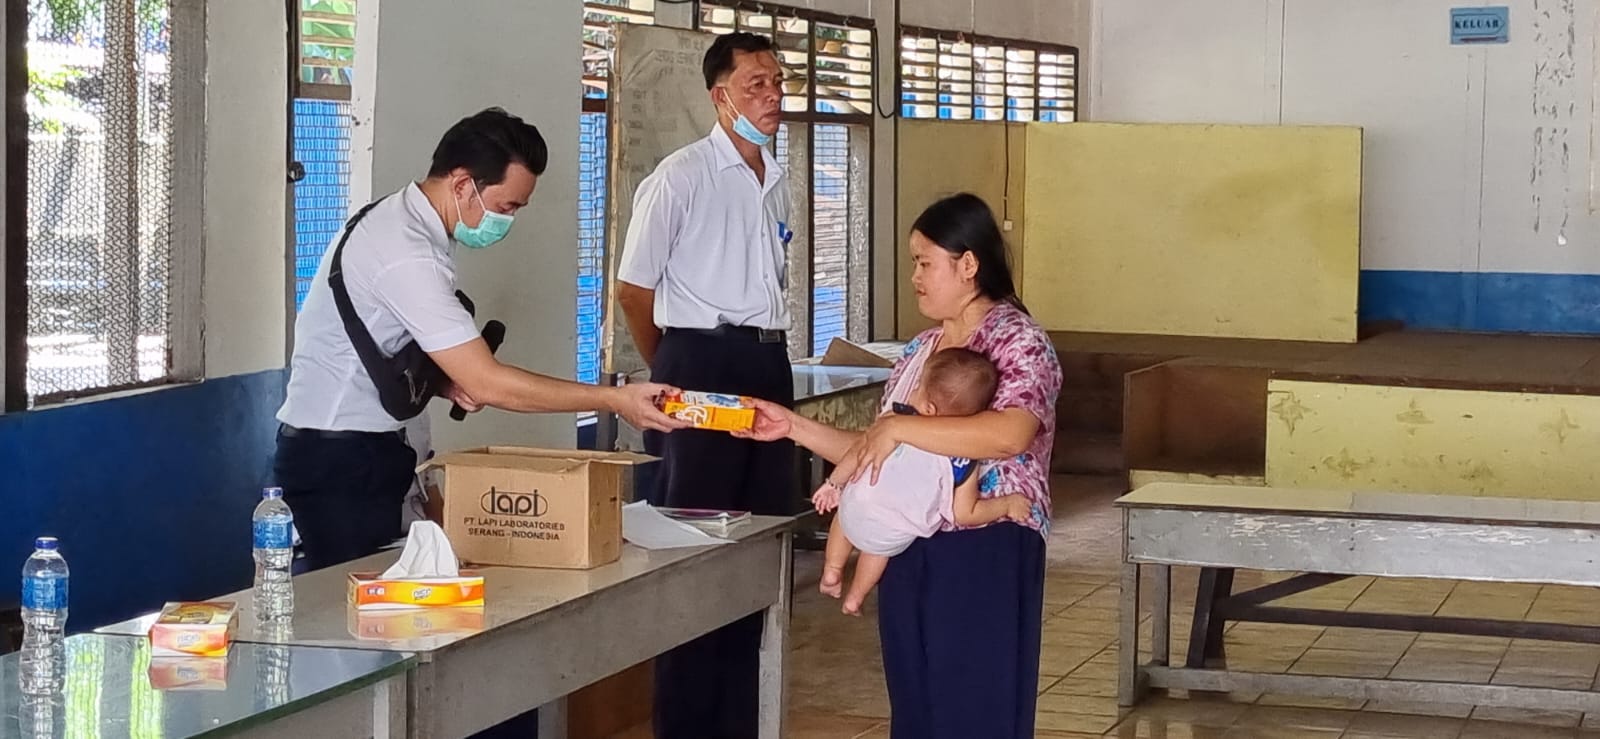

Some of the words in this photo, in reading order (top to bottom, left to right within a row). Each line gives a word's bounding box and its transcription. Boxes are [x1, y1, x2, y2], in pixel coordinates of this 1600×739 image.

[478, 517, 498, 527] LAPI
[499, 519, 565, 531] LABORATORIES
[468, 527, 505, 537] SERANG
[512, 530, 560, 541] INDONESIA
